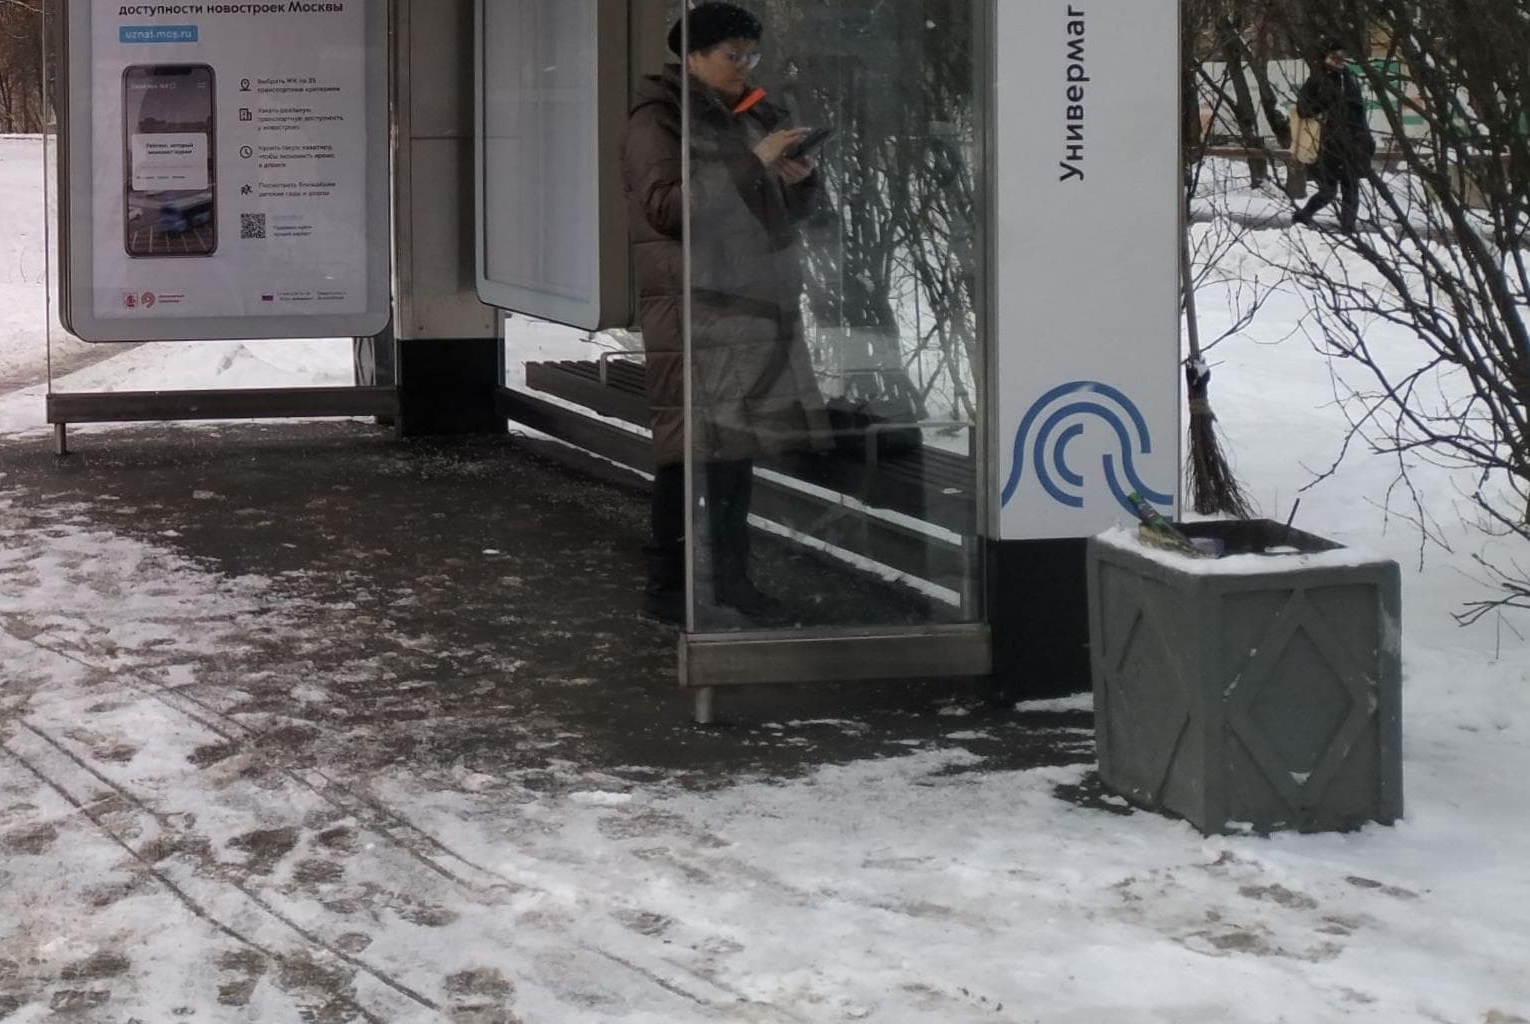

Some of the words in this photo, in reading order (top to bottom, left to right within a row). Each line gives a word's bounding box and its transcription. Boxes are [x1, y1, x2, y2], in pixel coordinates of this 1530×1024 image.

[118, 2, 203, 17] доступности
[206, 2, 285, 16] новостроек
[288, 1, 344, 13] Москвы
[1059, 4, 1090, 182] Универмаг
